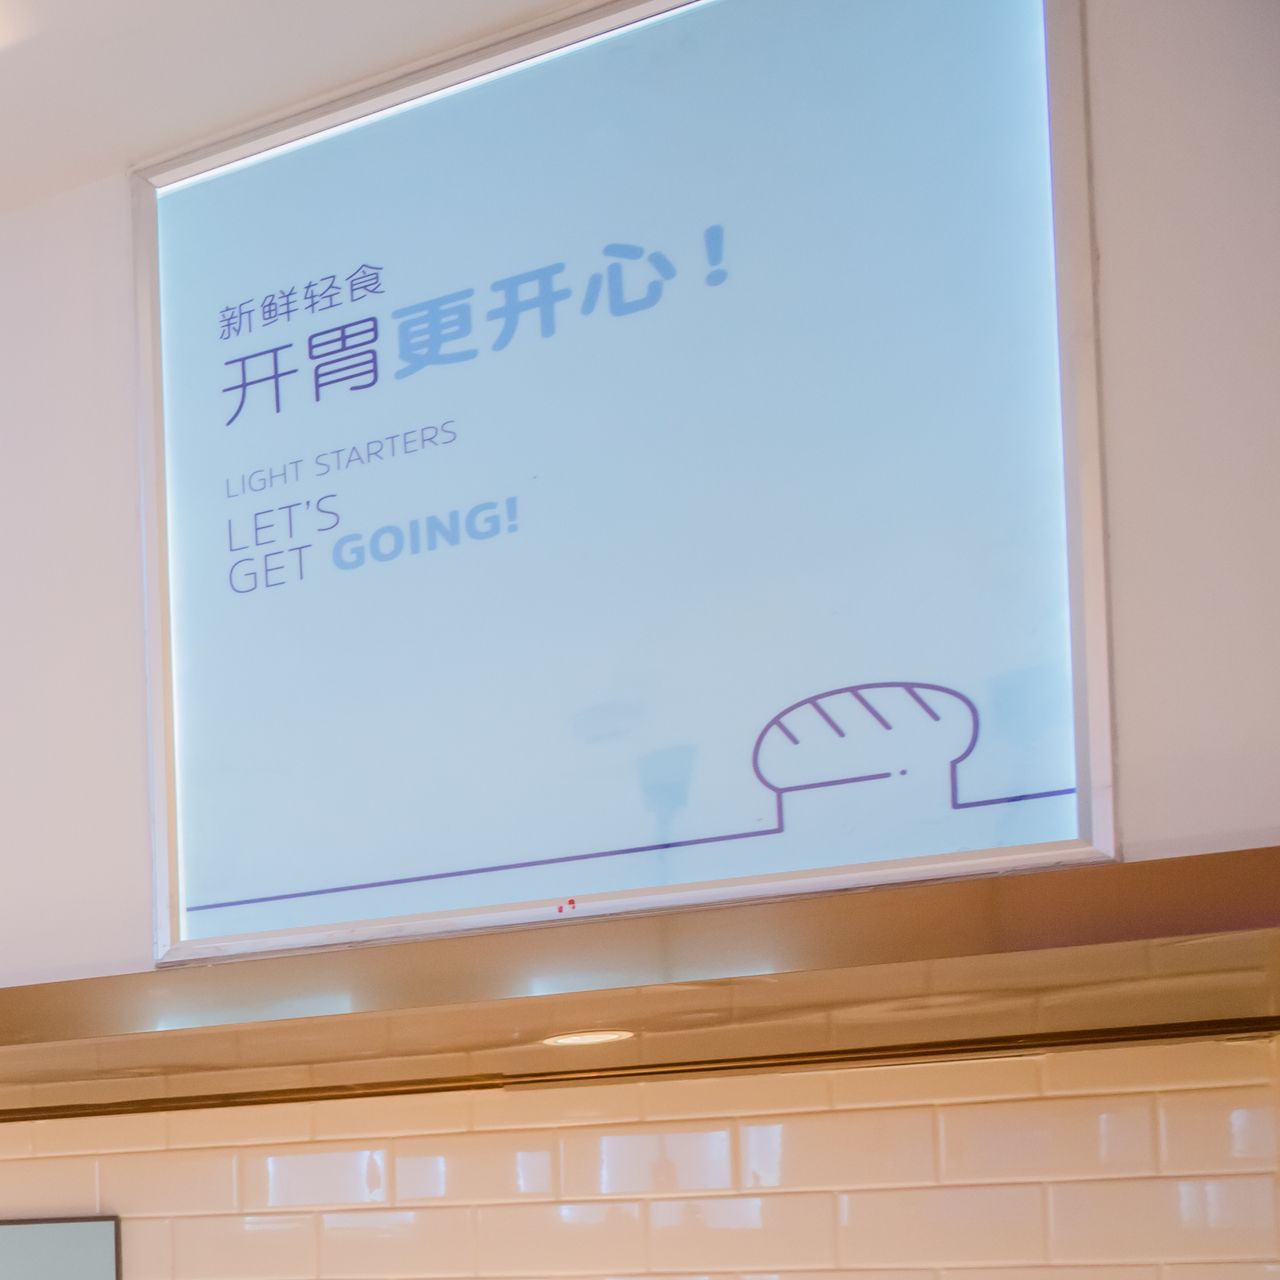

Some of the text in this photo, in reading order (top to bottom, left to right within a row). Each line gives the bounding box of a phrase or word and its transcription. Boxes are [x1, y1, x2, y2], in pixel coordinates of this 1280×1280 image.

[219, 263, 386, 341] 新鲜轻食
[222, 224, 728, 427] 开胃更开心！
[225, 420, 458, 499] LIGHT STARTERS
[228, 494, 341, 552] LET'S
[229, 496, 519, 594] GET GOING!
